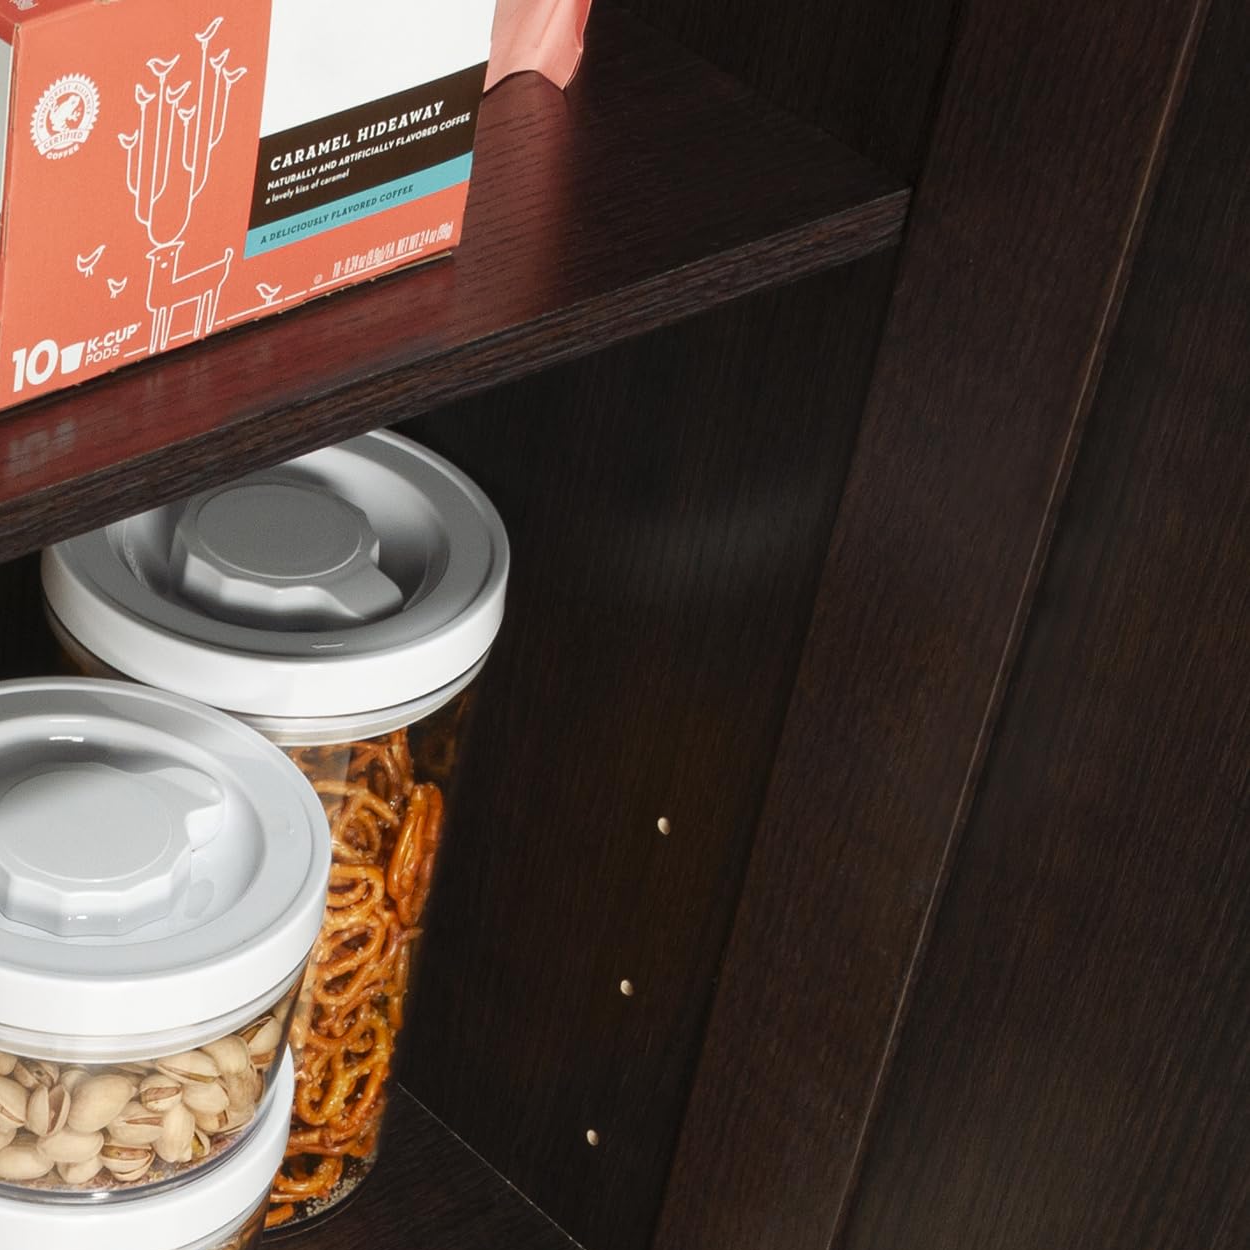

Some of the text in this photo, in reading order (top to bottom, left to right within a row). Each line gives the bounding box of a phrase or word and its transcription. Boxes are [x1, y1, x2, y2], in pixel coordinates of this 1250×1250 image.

[43, 132, 83, 149] CERTIFIED
[46, 144, 79, 160] COFFEE
[267, 111, 471, 190] NATURALLY AND ARTIFICIALLY FLAVORED COFFEE
[269, 100, 444, 172] CARAMEL HIDEAWAY
[271, 188, 294, 204] lovely
[295, 181, 310, 195] kiss
[310, 178, 320, 190] of
[320, 169, 350, 186] caramel
[260, 184, 414, 245] A DELICIOUSLY FLAVORED COFFEE
[12, 339, 59, 393] 10
[85, 345, 120, 367] PODS
